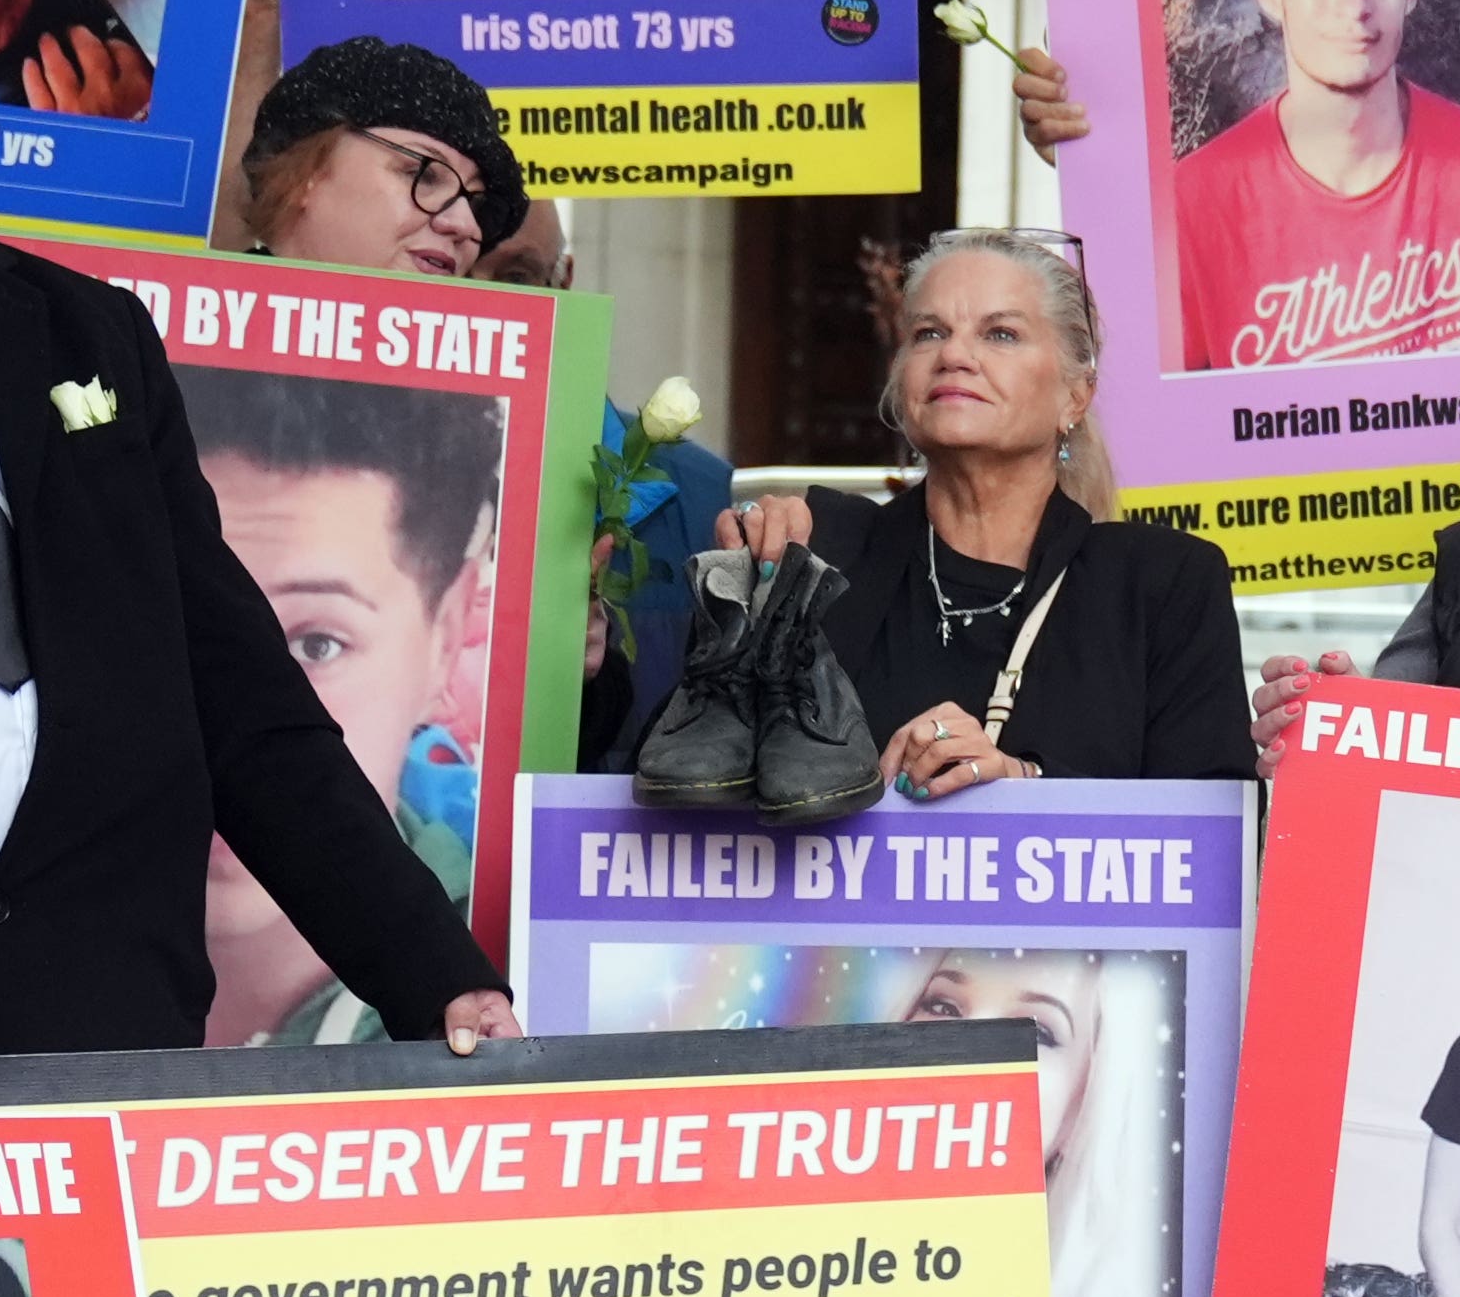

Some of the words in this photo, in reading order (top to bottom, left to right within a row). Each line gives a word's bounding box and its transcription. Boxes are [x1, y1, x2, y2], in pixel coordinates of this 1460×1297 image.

[461, 13, 522, 51] Iris
[527, 12, 620, 51] Scott
[631, 11, 673, 49] 73
[678, 16, 735, 52] yrs
[0, 131, 55, 167] yrs
[1233, 403, 1341, 442] Darian
[157, 1122, 531, 1208] DESERVE
[550, 1114, 709, 1188] THE
[727, 1101, 1012, 1179] TRUTH!
[913, 1239, 962, 1282] to
